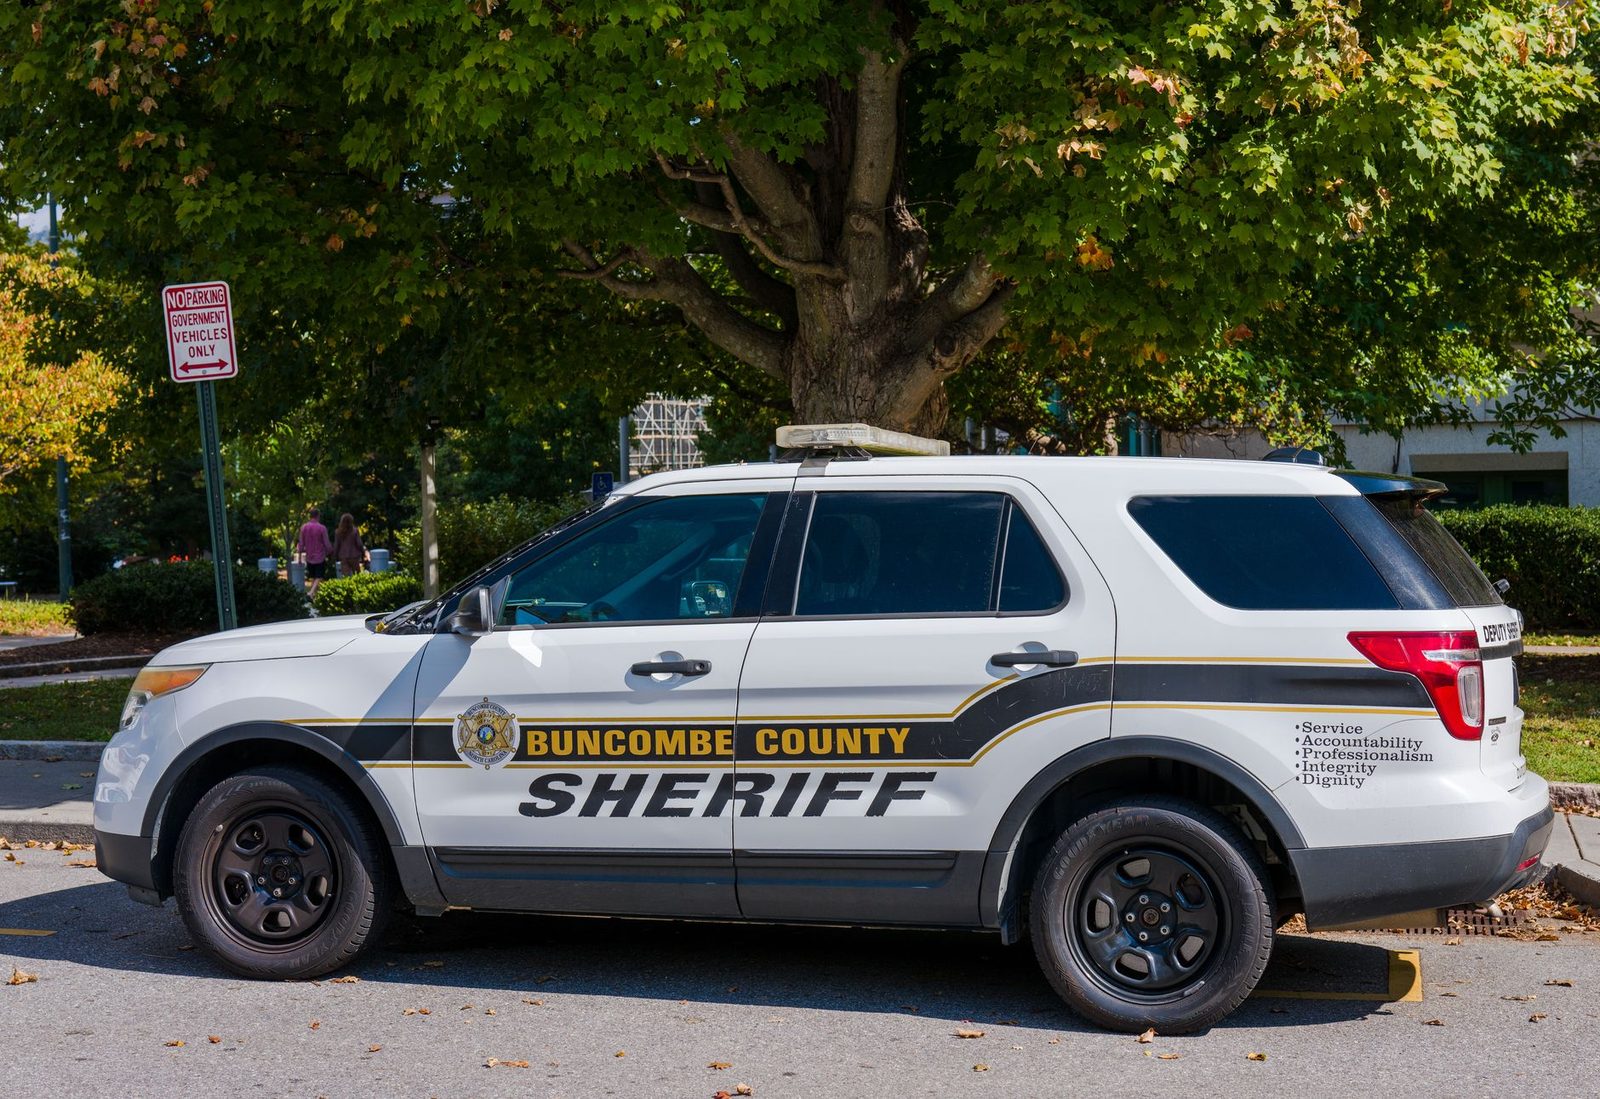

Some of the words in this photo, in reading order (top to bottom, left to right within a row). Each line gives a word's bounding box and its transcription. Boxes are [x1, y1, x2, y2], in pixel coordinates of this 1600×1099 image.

[167, 291, 185, 309] NO
[186, 289, 224, 306] PARKING
[172, 311, 225, 327] GOVERNMENT
[174, 328, 227, 343] VEHICLES
[188, 344, 215, 358] ONLY
[1483, 623, 1507, 643] DEPUTY
[1302, 721, 1363, 735] Service
[526, 729, 734, 757] BUNCOMBE
[755, 727, 911, 755] COUNTY
[1301, 735, 1423, 751] Accountability
[1302, 747, 1434, 762] Professionalism
[1302, 760, 1377, 776] Integrity
[1302, 773, 1365, 789] Dignity
[518, 771, 938, 818] SHERIFF
